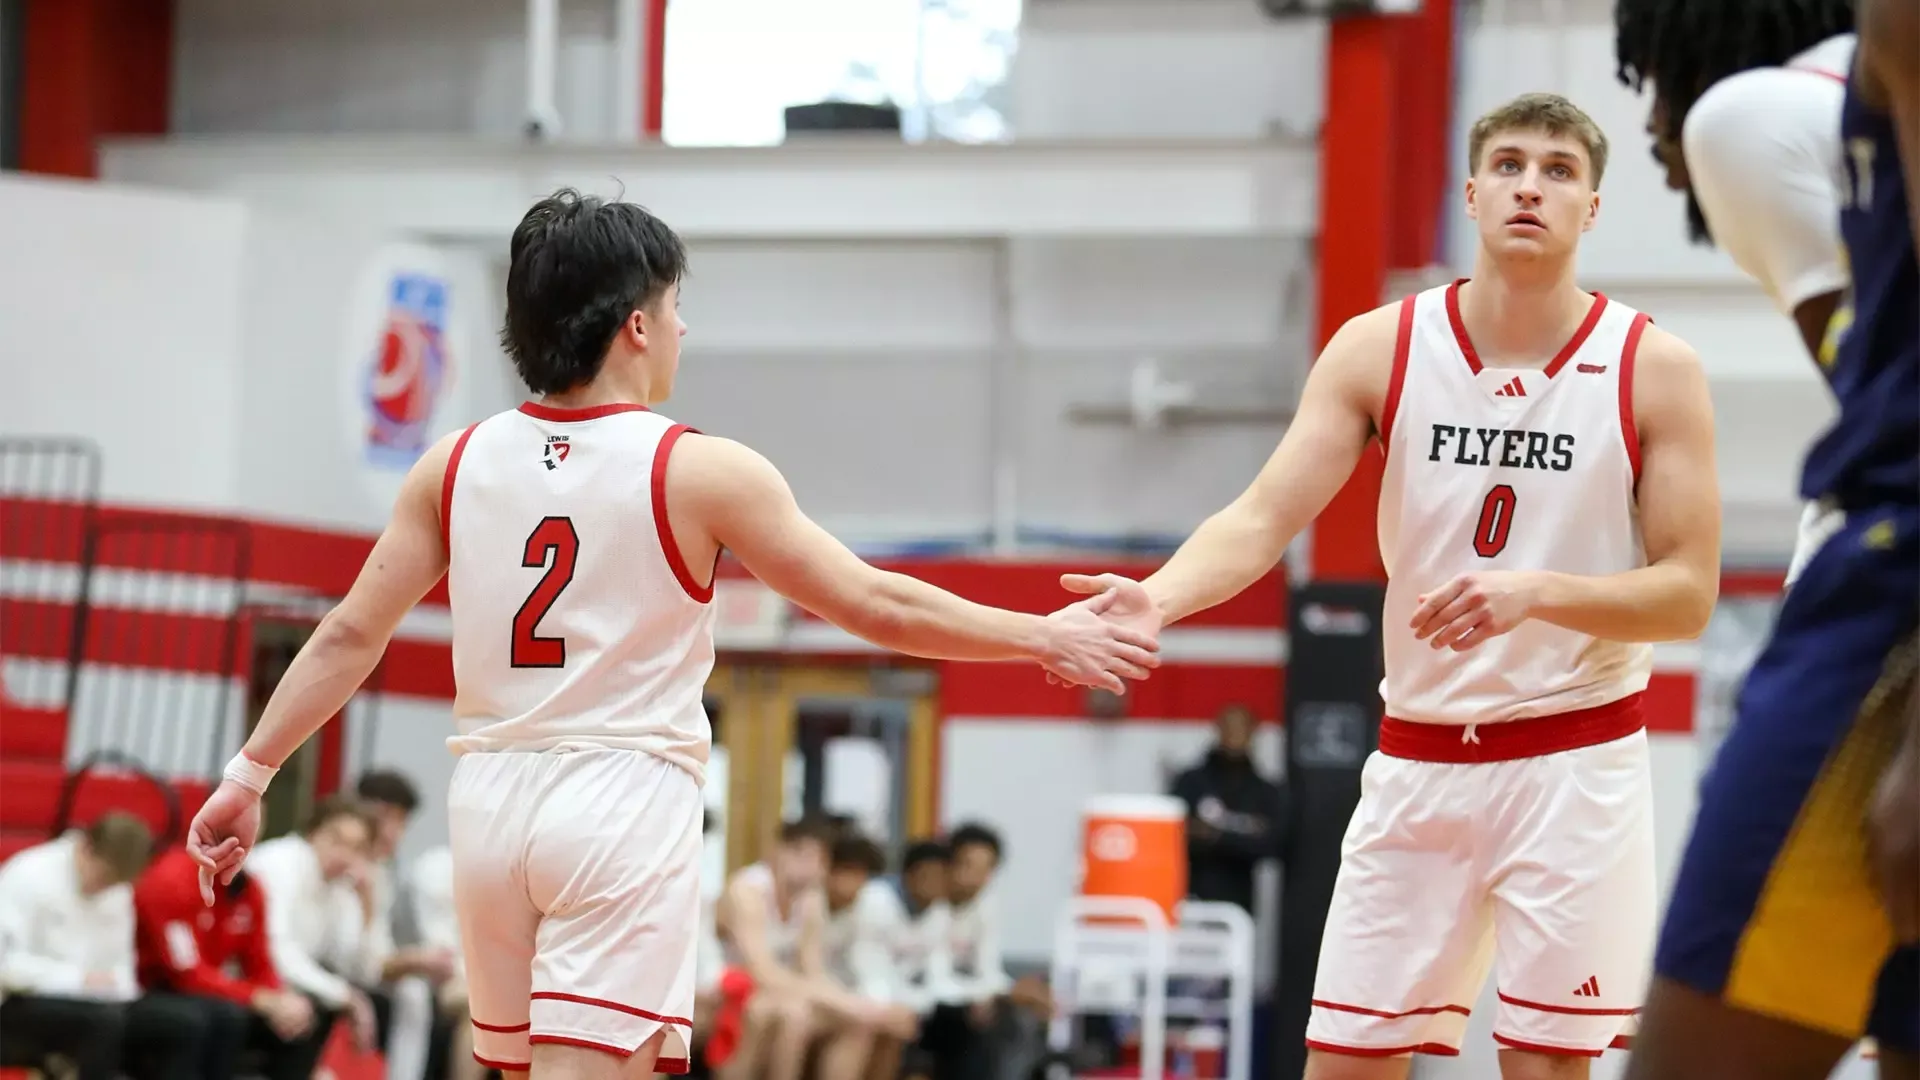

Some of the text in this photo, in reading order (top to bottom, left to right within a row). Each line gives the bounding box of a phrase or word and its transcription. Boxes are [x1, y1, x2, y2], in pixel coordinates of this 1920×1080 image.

[547, 435, 570, 443] LEWIS
[1429, 424, 1575, 471] FLYERS
[1473, 484, 1517, 558] 0
[511, 516, 579, 668] 2
